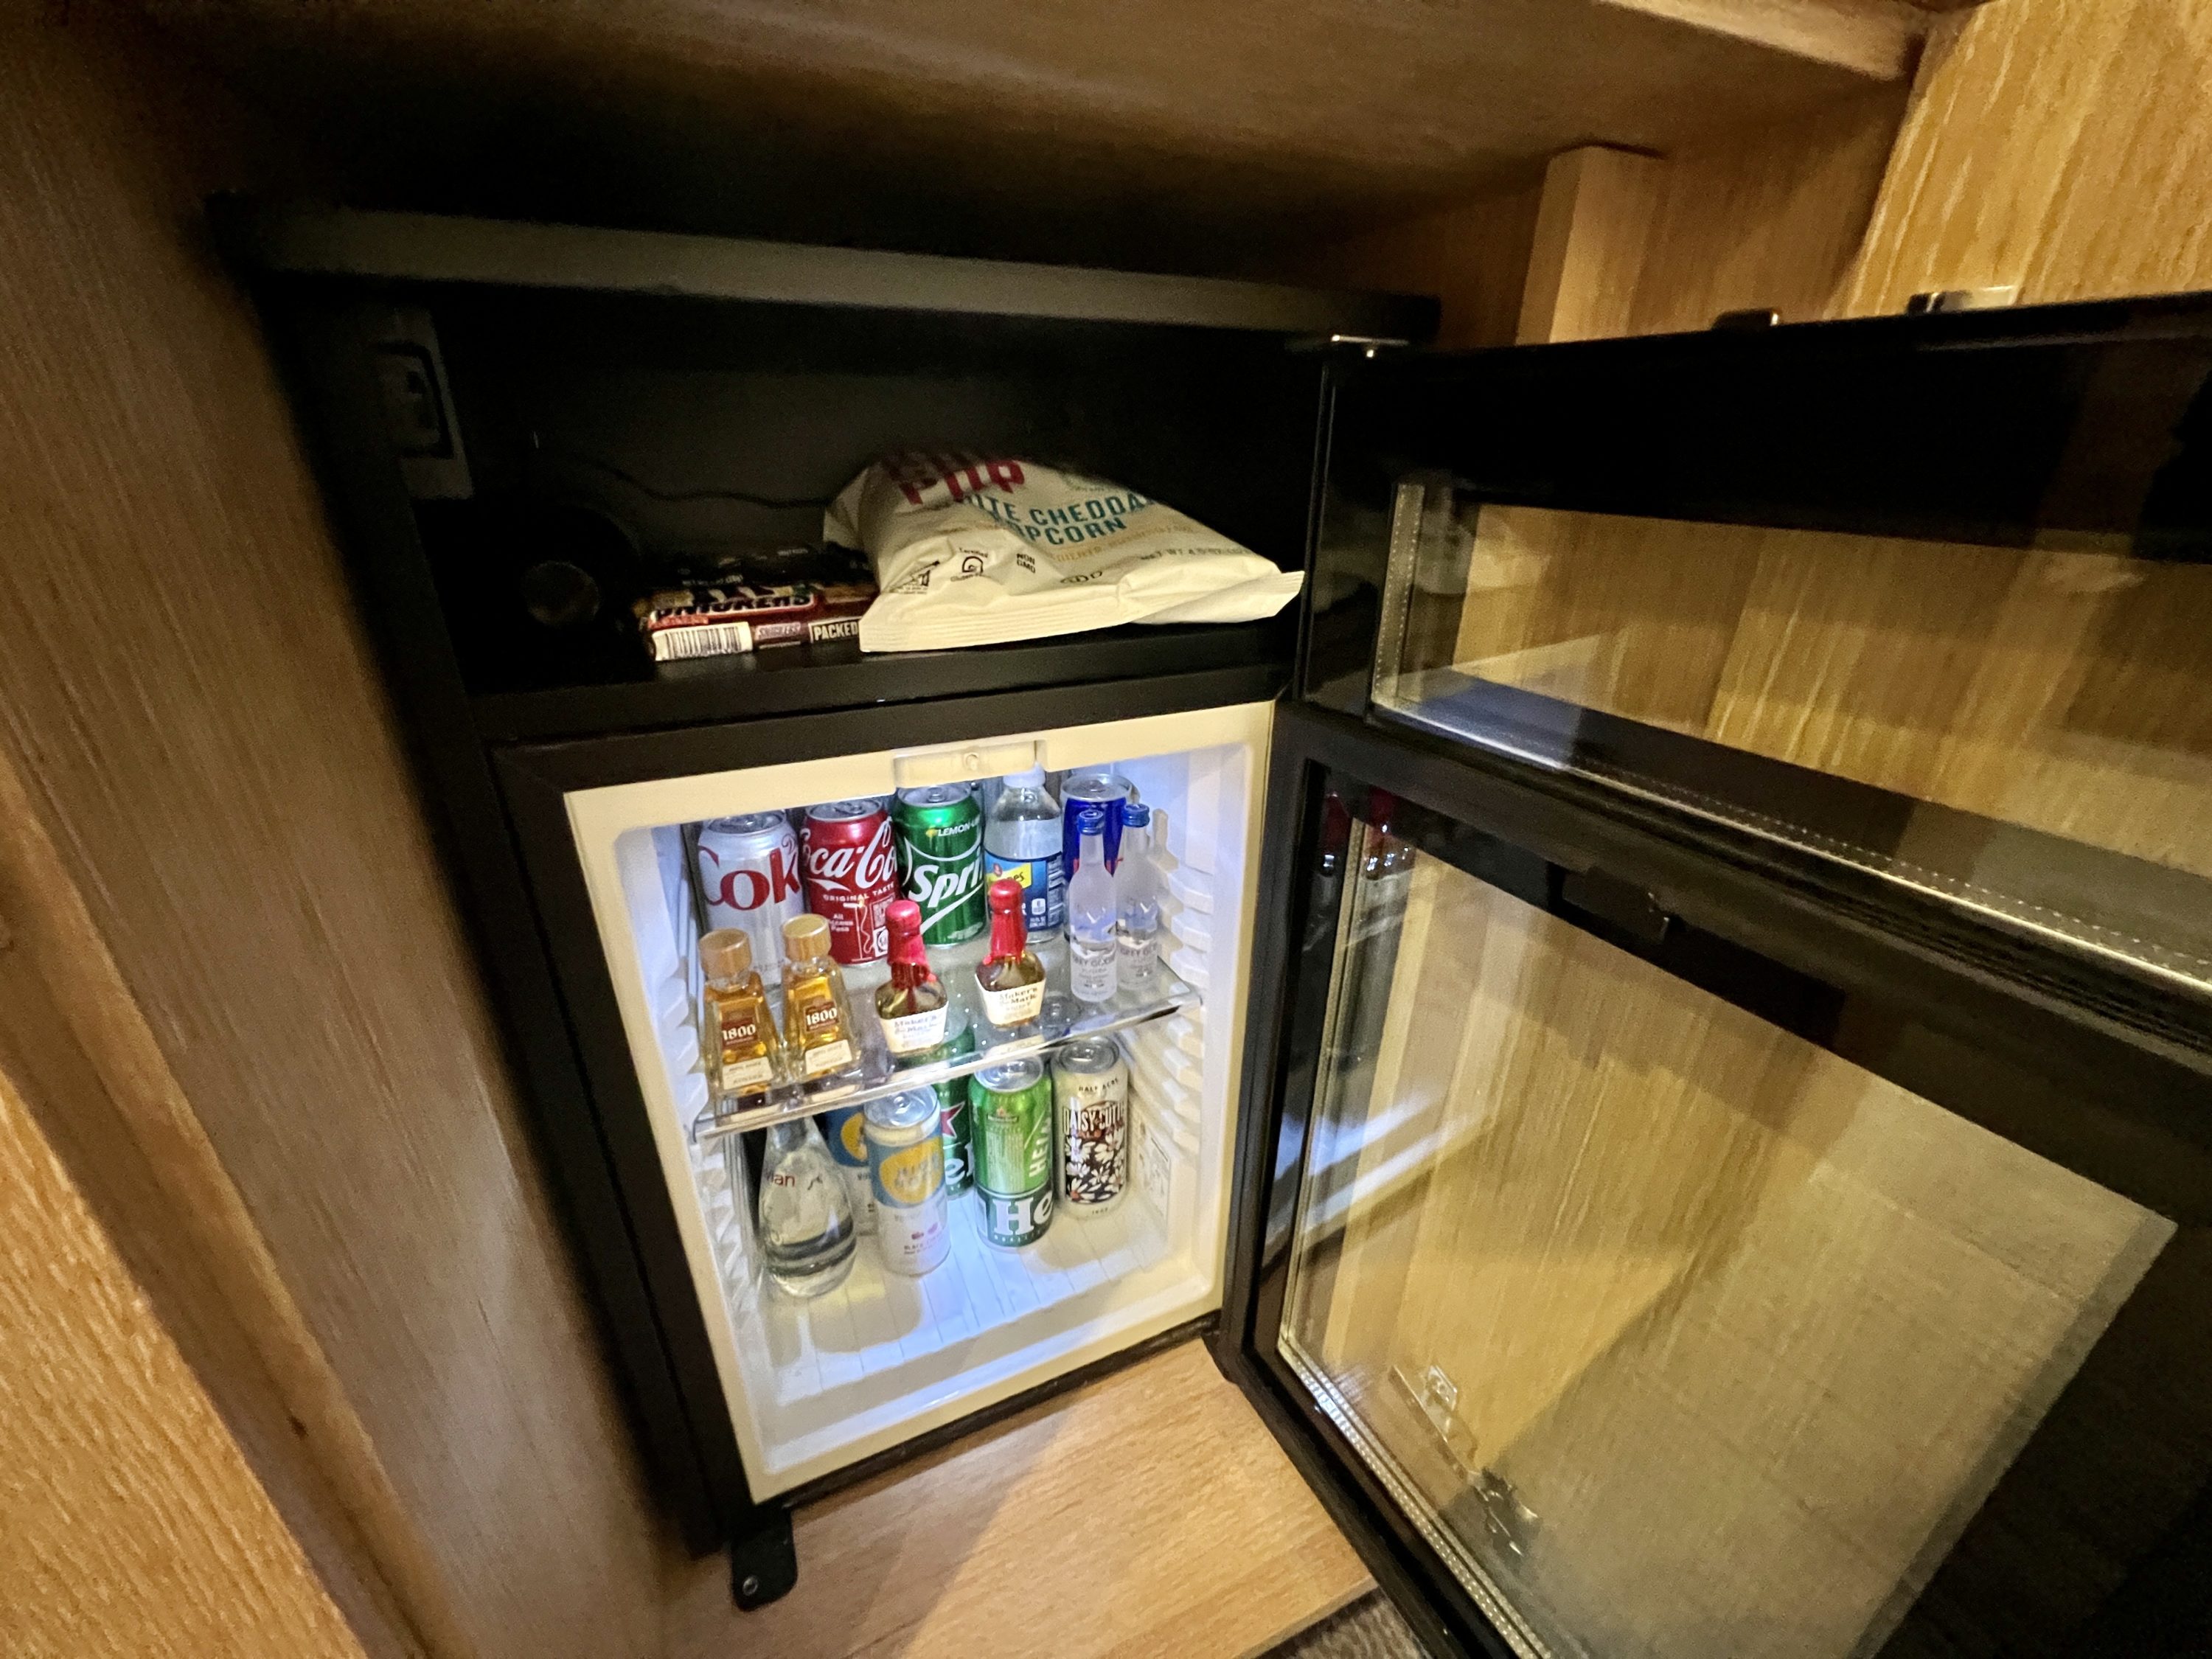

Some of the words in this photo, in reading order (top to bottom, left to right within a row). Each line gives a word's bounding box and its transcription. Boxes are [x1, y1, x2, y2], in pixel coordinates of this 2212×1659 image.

[1029, 492, 1155, 526] CHEDDA
[1006, 517, 1127, 546] OPCORN
[1016, 553, 1035, 566] NON
[1016, 559, 1036, 574] GMO
[813, 622, 859, 641] PACKED
[823, 893, 870, 902] ORIGINAL
[1010, 992, 1037, 1004] Mark
[806, 1007, 838, 1026] 1800
[721, 1023, 757, 1041] 1800
[1062, 1106, 1096, 1135] DAISY
